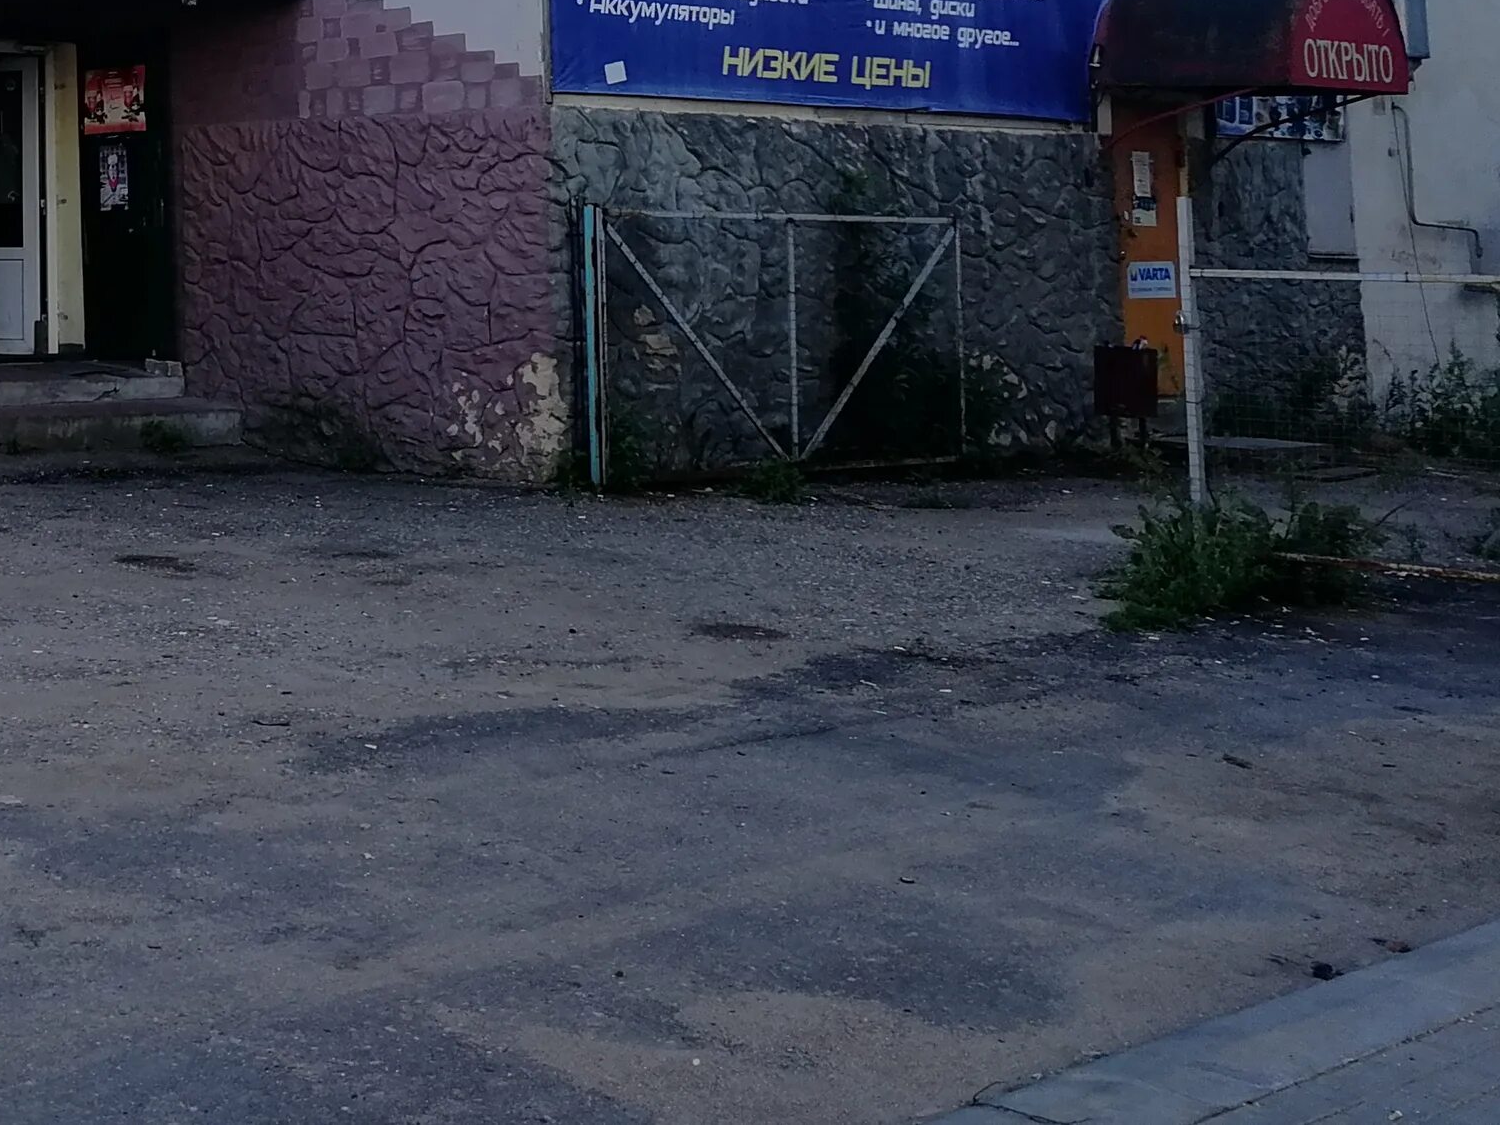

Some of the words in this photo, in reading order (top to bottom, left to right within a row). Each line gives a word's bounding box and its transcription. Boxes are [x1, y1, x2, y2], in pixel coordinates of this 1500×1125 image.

[930, 0, 975, 20] диски
[875, 19, 886, 35] и
[893, 21, 950, 40] многое
[722, 45, 839, 83] НИЗКИЕ
[850, 55, 931, 90] ЦЕНЫ
[1303, 38, 1393, 83] ОТКРЫТО
[1138, 267, 1171, 281] VARTA
